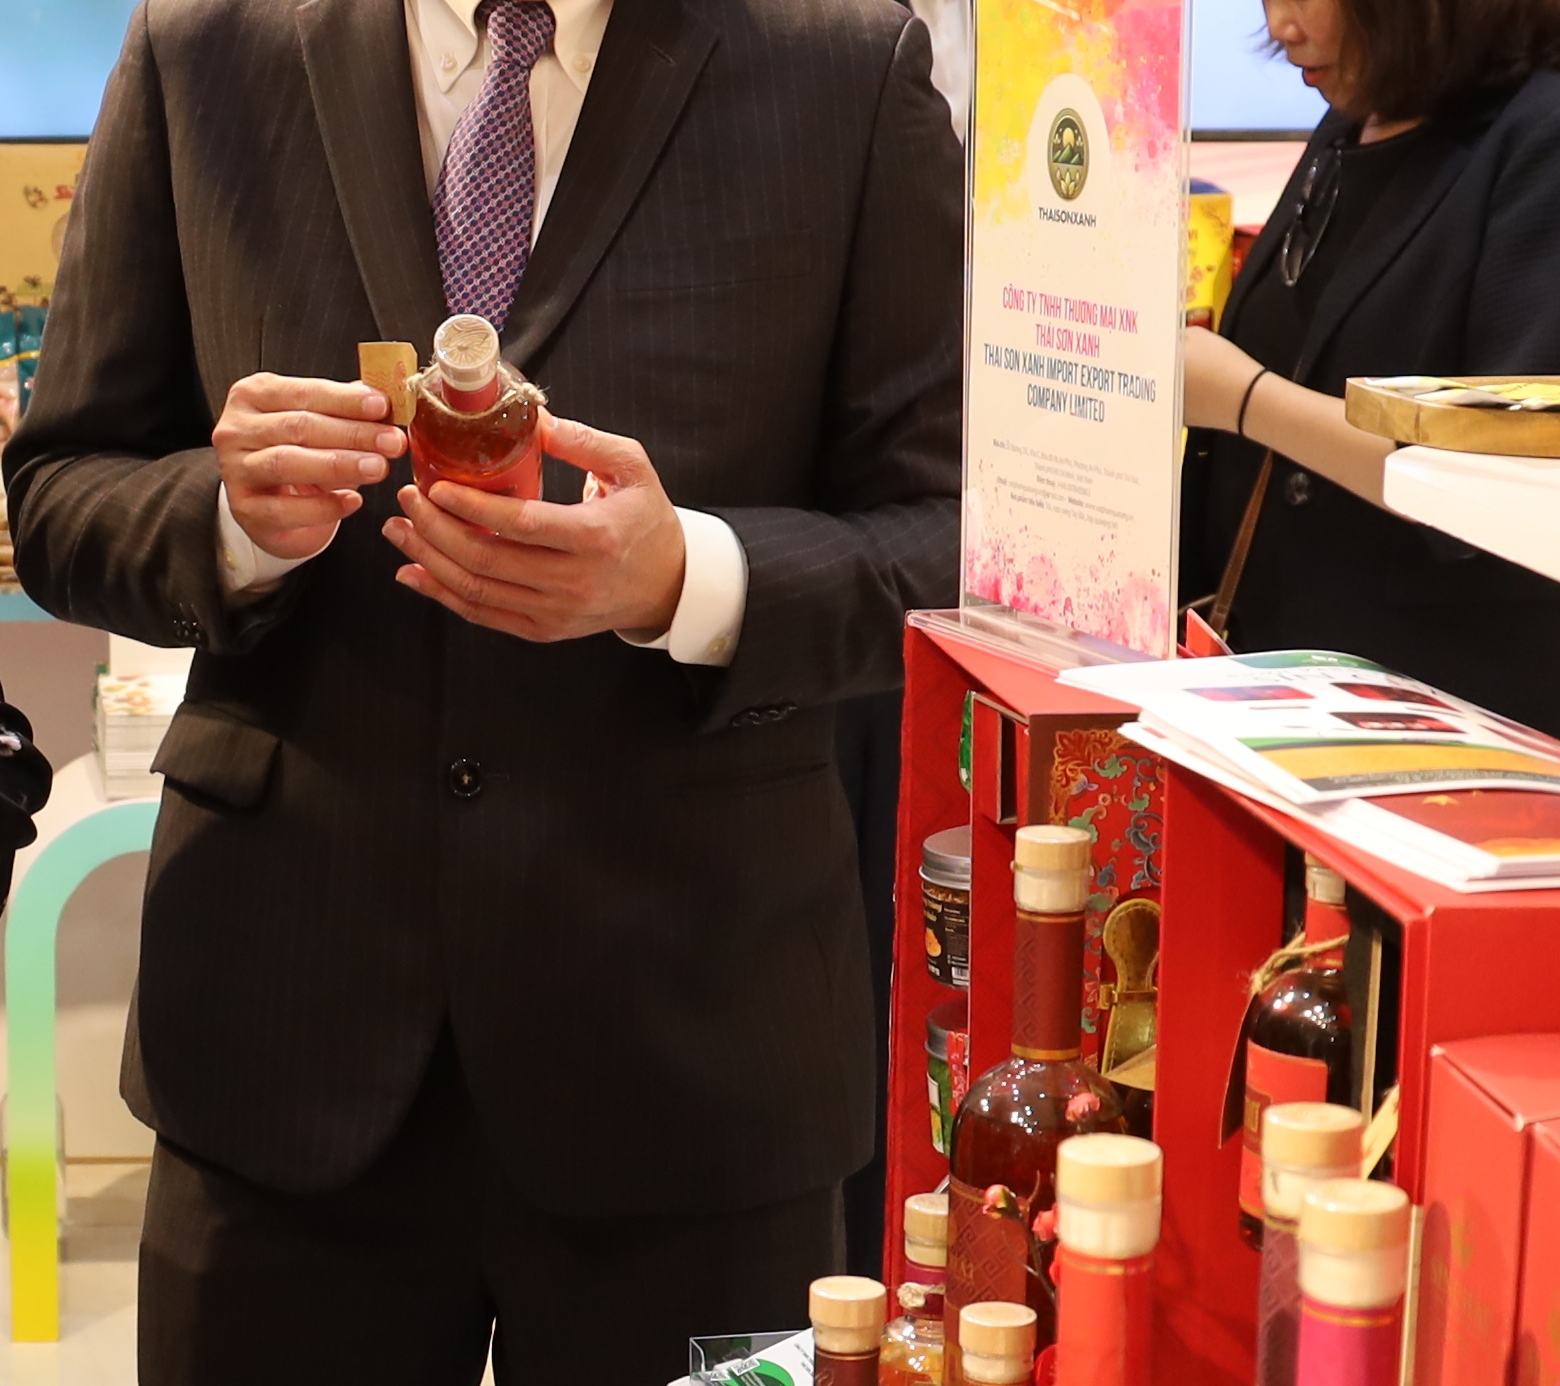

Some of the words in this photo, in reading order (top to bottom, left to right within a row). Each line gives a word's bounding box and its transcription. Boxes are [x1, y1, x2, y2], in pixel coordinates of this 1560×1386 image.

[1038, 206, 1097, 227] THAISONXANH
[1003, 284, 1025, 312] CÔNG
[1027, 291, 1037, 313] TY
[1039, 293, 1062, 318] TNHH
[1099, 304, 1116, 334] MẠI
[1118, 307, 1138, 333] XNK
[1035, 322, 1054, 347] THÁI
[1055, 327, 1073, 352] SƠN
[1075, 332, 1100, 358] XANH
[984, 343, 1002, 367] THAI
[1003, 348, 1020, 371] SON
[1021, 352, 1045, 377] XANH
[1046, 356, 1079, 385] IMPORT
[1080, 364, 1115, 394] EXPORT
[1117, 371, 1156, 403] TRADING
[1027, 383, 1067, 413] COMPANY
[1069, 396, 1105, 422] LIMITED
